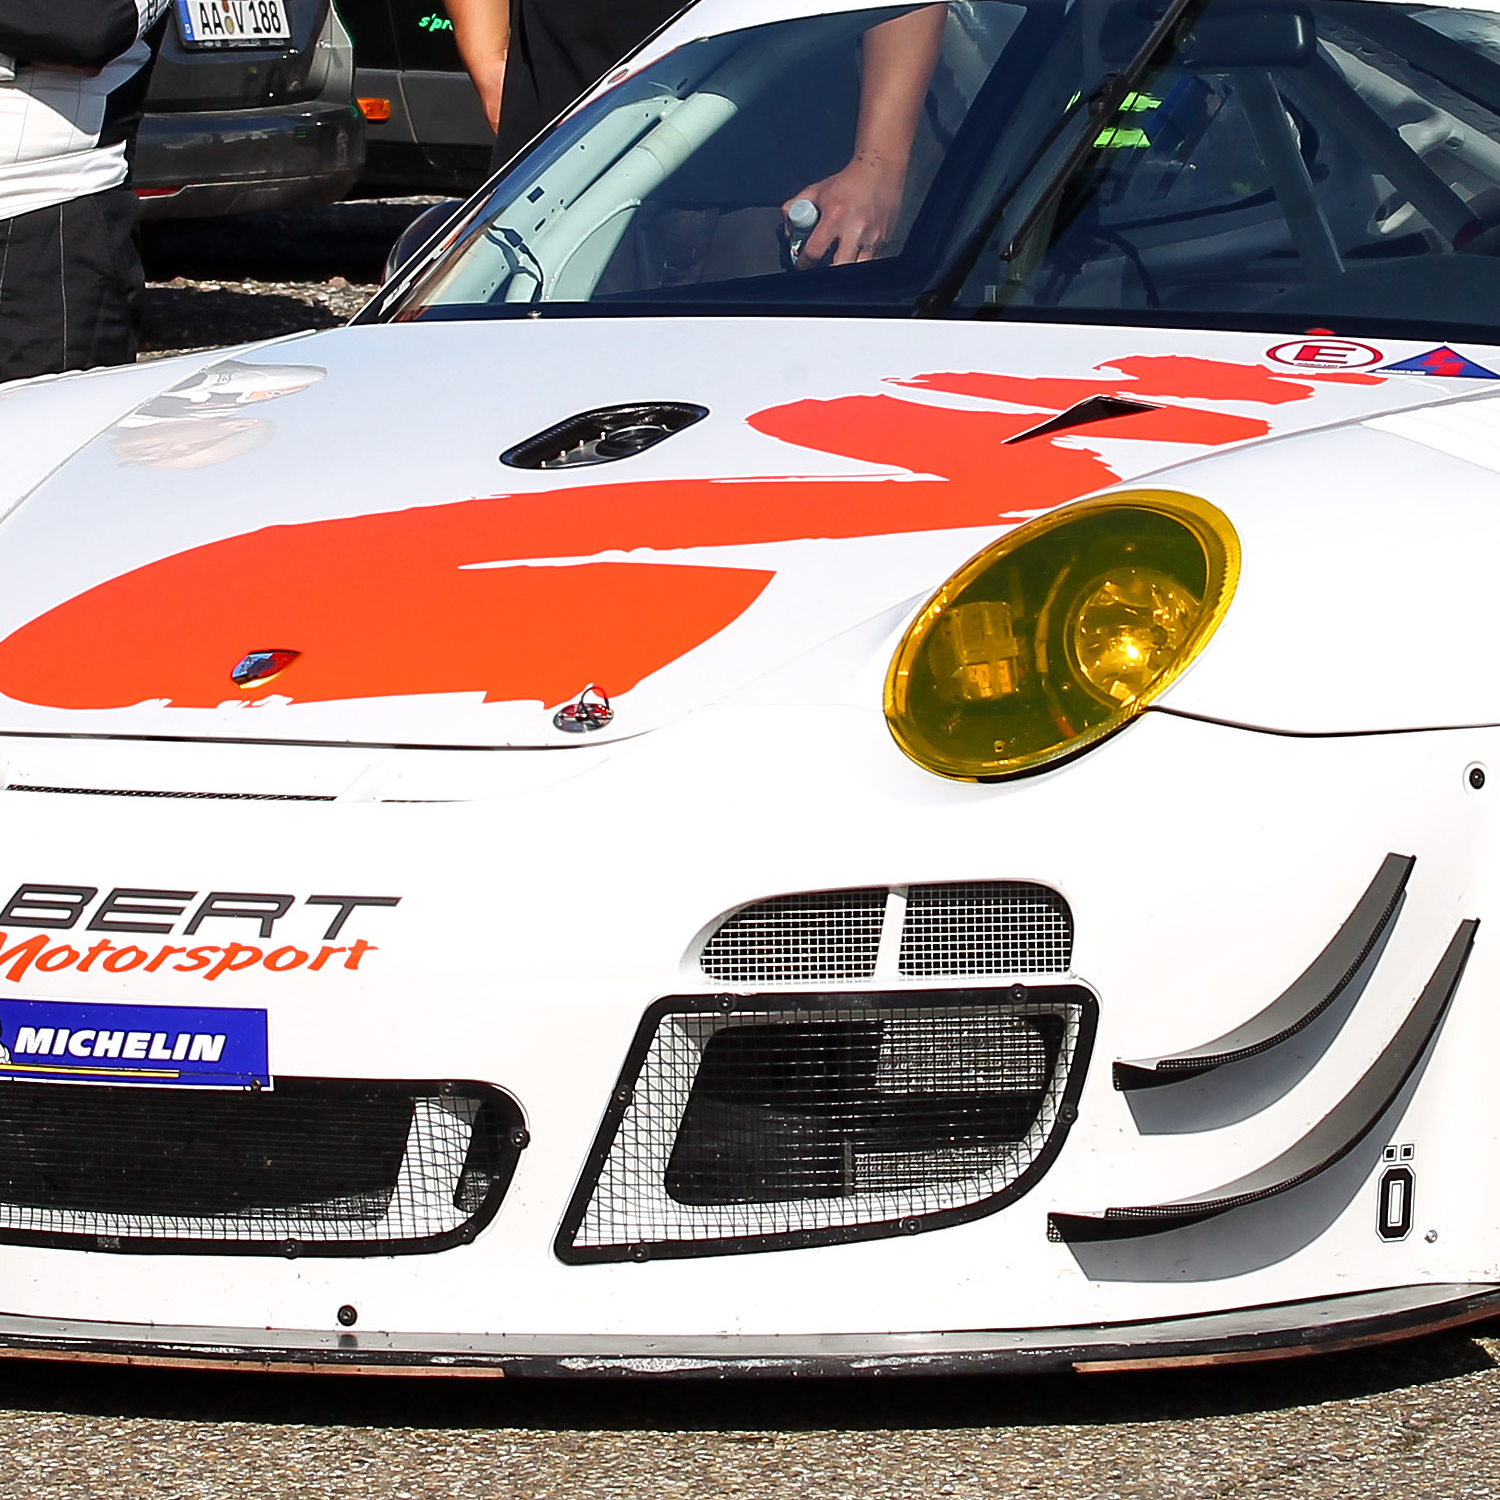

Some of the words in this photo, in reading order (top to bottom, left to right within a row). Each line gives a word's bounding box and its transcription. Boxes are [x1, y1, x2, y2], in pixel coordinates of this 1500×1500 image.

[199, 1, 225, 36] AA
[232, 1, 245, 34] V
[248, 0, 282, 34] 188
[14, 1026, 227, 1064] MICHELIN
